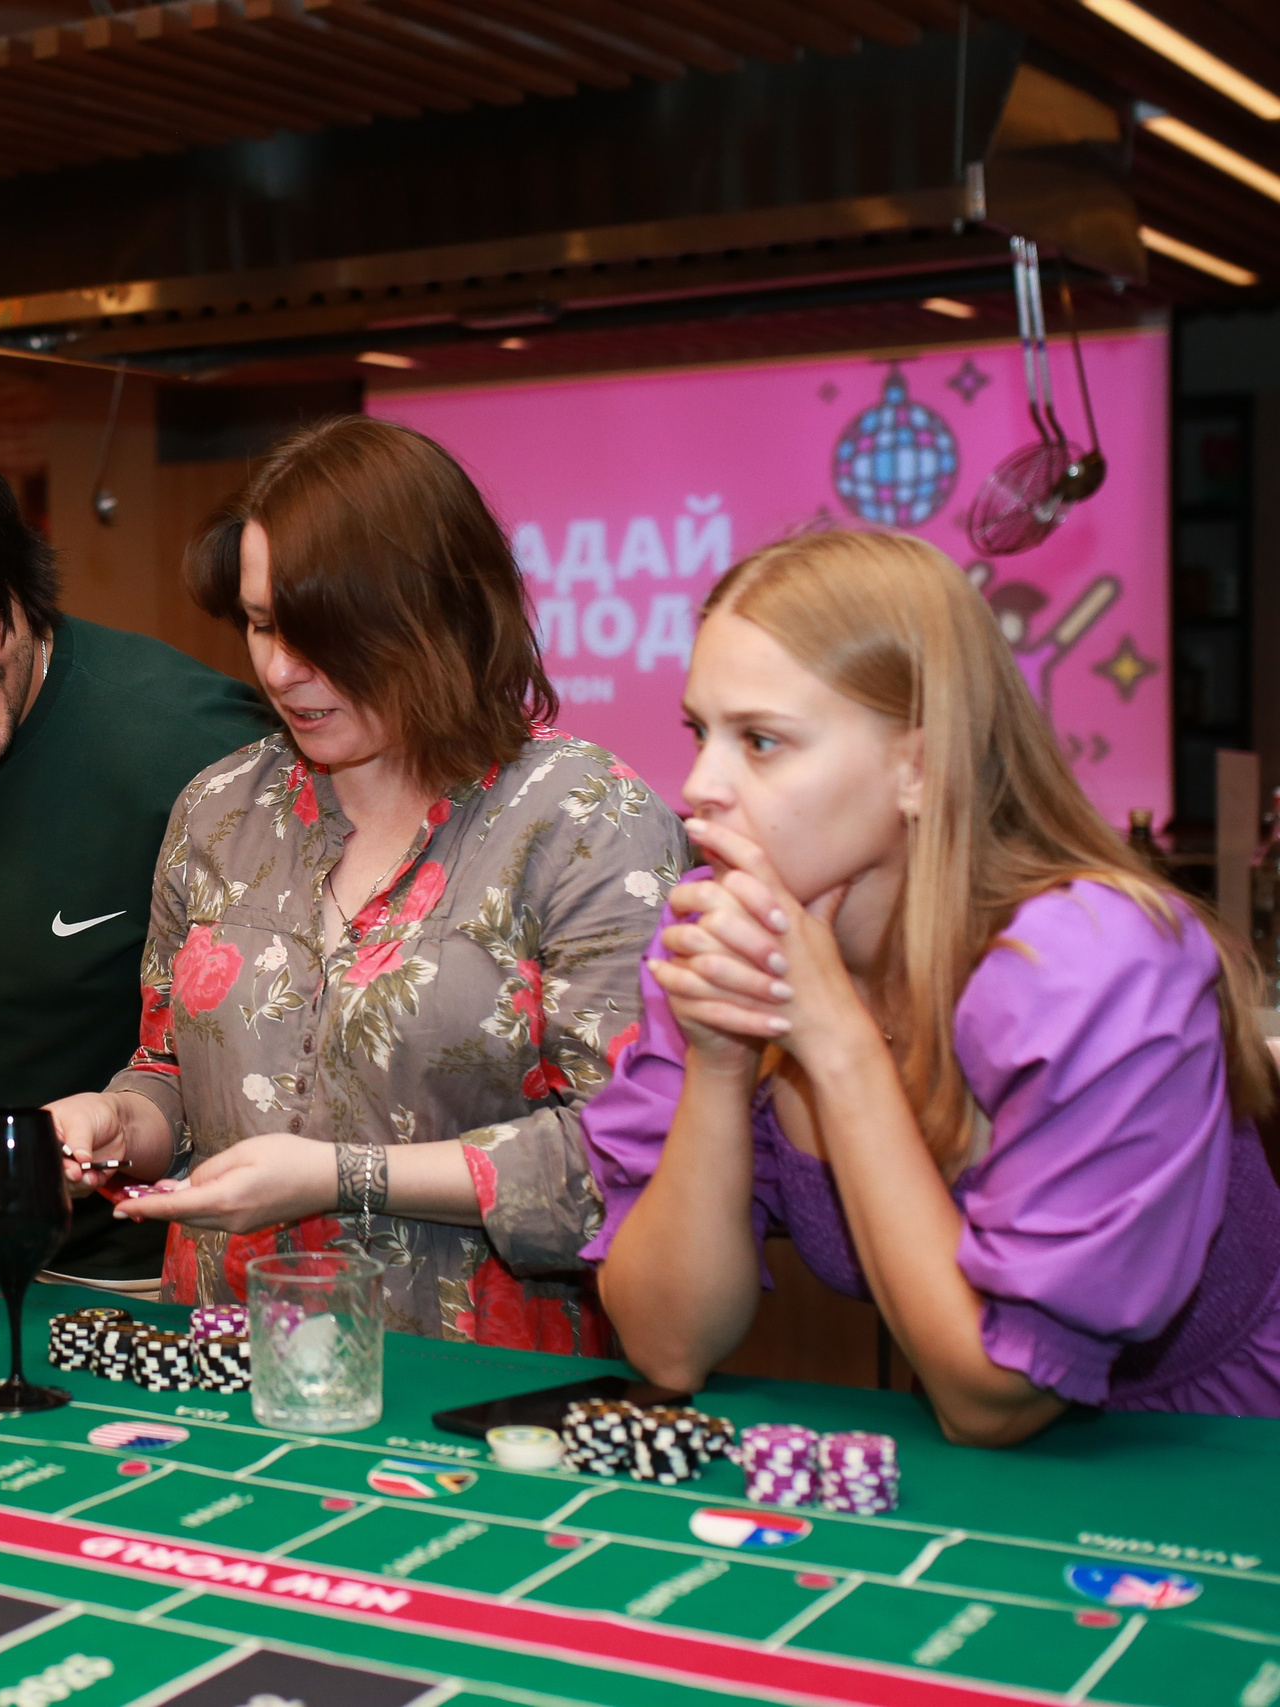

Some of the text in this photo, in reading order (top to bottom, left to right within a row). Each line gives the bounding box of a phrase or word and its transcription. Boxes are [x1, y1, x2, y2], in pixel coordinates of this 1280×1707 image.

[511, 493, 733, 596] АДАЙ
[533, 594, 696, 672] ЛОД
[79, 1535, 412, 1614] NEW WORLD
